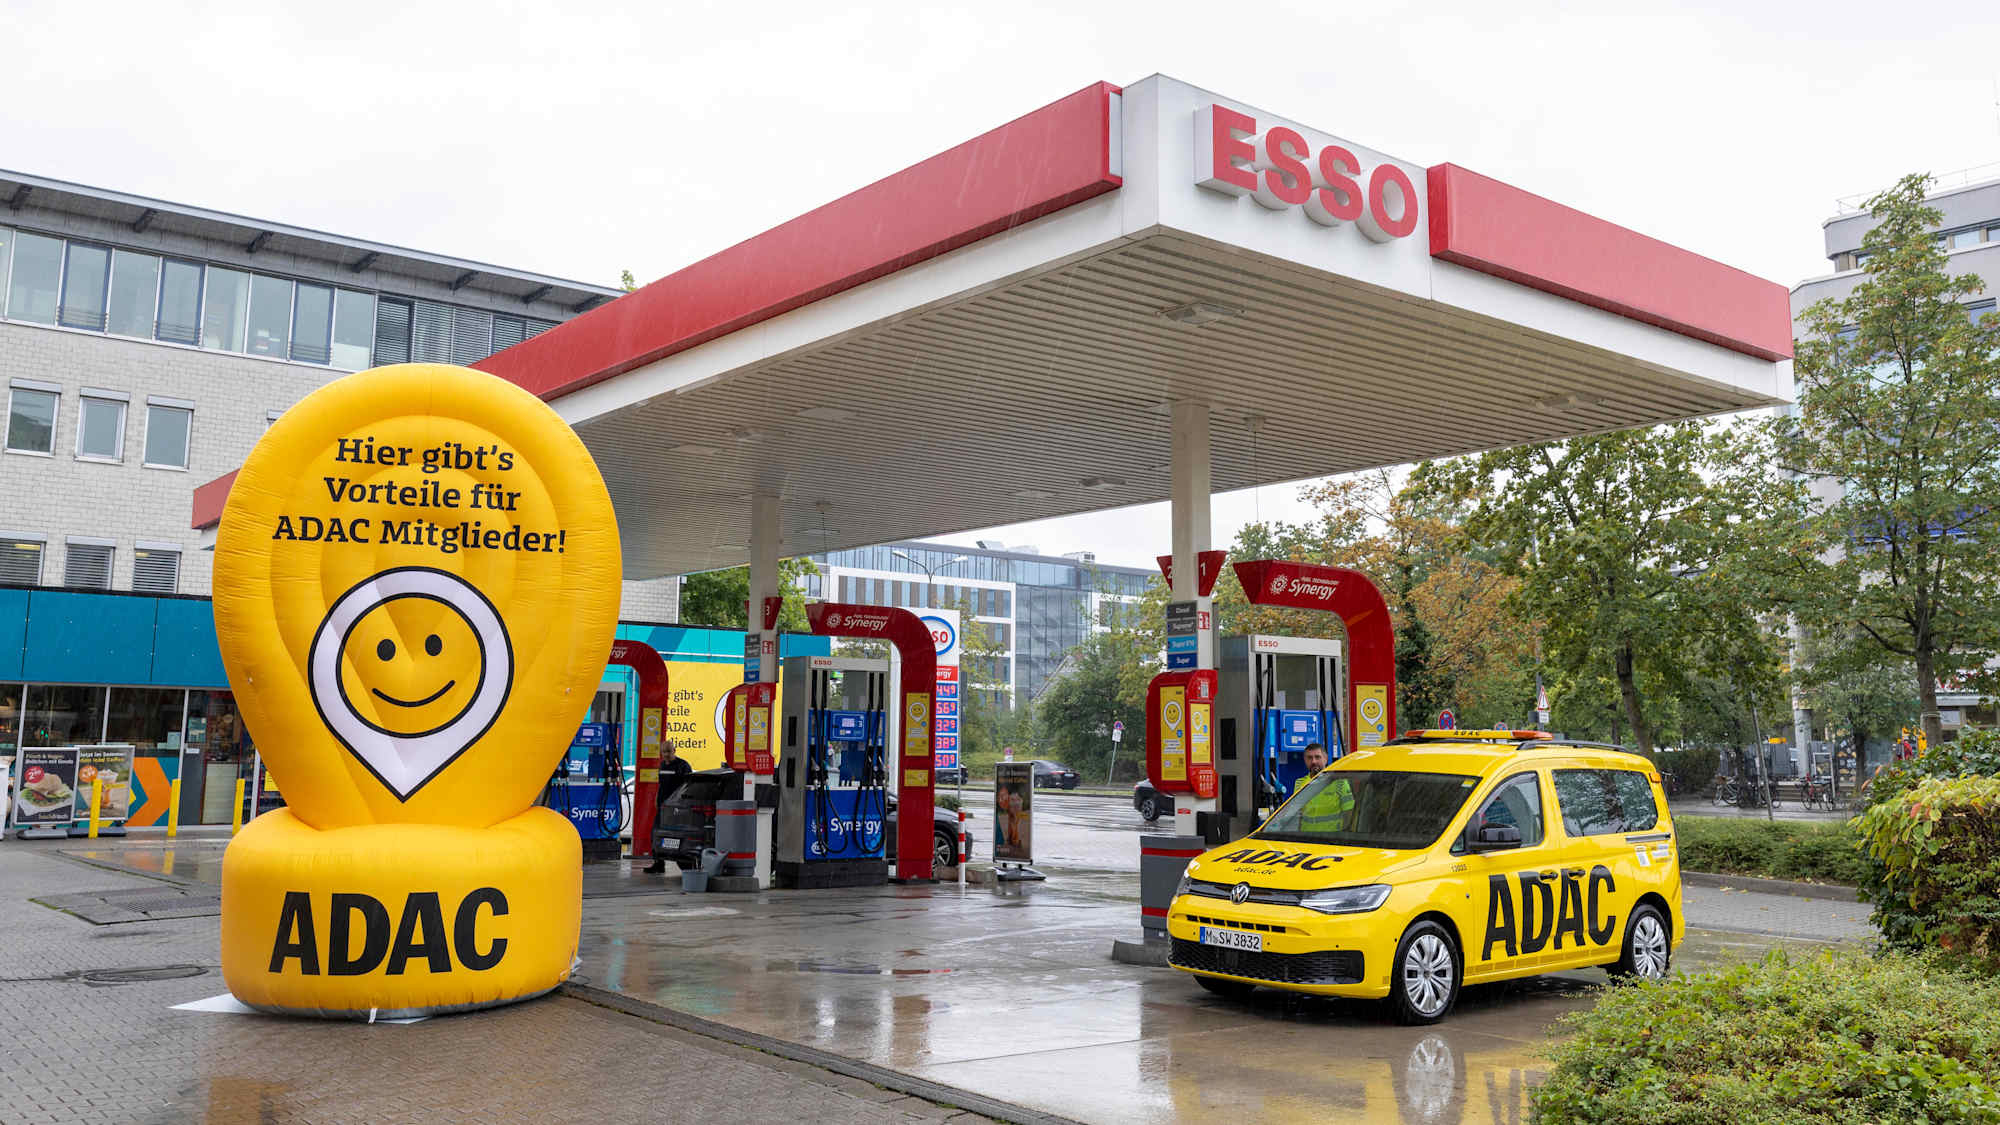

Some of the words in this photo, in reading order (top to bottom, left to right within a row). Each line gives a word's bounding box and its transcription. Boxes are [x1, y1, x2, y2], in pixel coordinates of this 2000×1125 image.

[1211, 103, 1419, 239] ESSO
[335, 437, 412, 467] Hier
[323, 476, 461, 509] Vorteile
[470, 483, 521, 511] für
[272, 515, 370, 544] ADAC
[379, 520, 566, 554] Mitglieder!
[1200, 562, 1206, 576] 1
[1288, 579, 1337, 600] Synergy
[843, 615, 888, 631] Synergy
[931, 630, 949, 644] SO
[1258, 640, 1279, 648] ESSO
[671, 737, 707, 749] lieder!
[571, 807, 617, 821] Synegy
[830, 817, 882, 836] Synegy
[1212, 849, 1344, 871] ADAC
[1482, 864, 1617, 961] ADAC
[267, 887, 510, 976] ADAC
[1233, 933, 1260, 950] 3832
